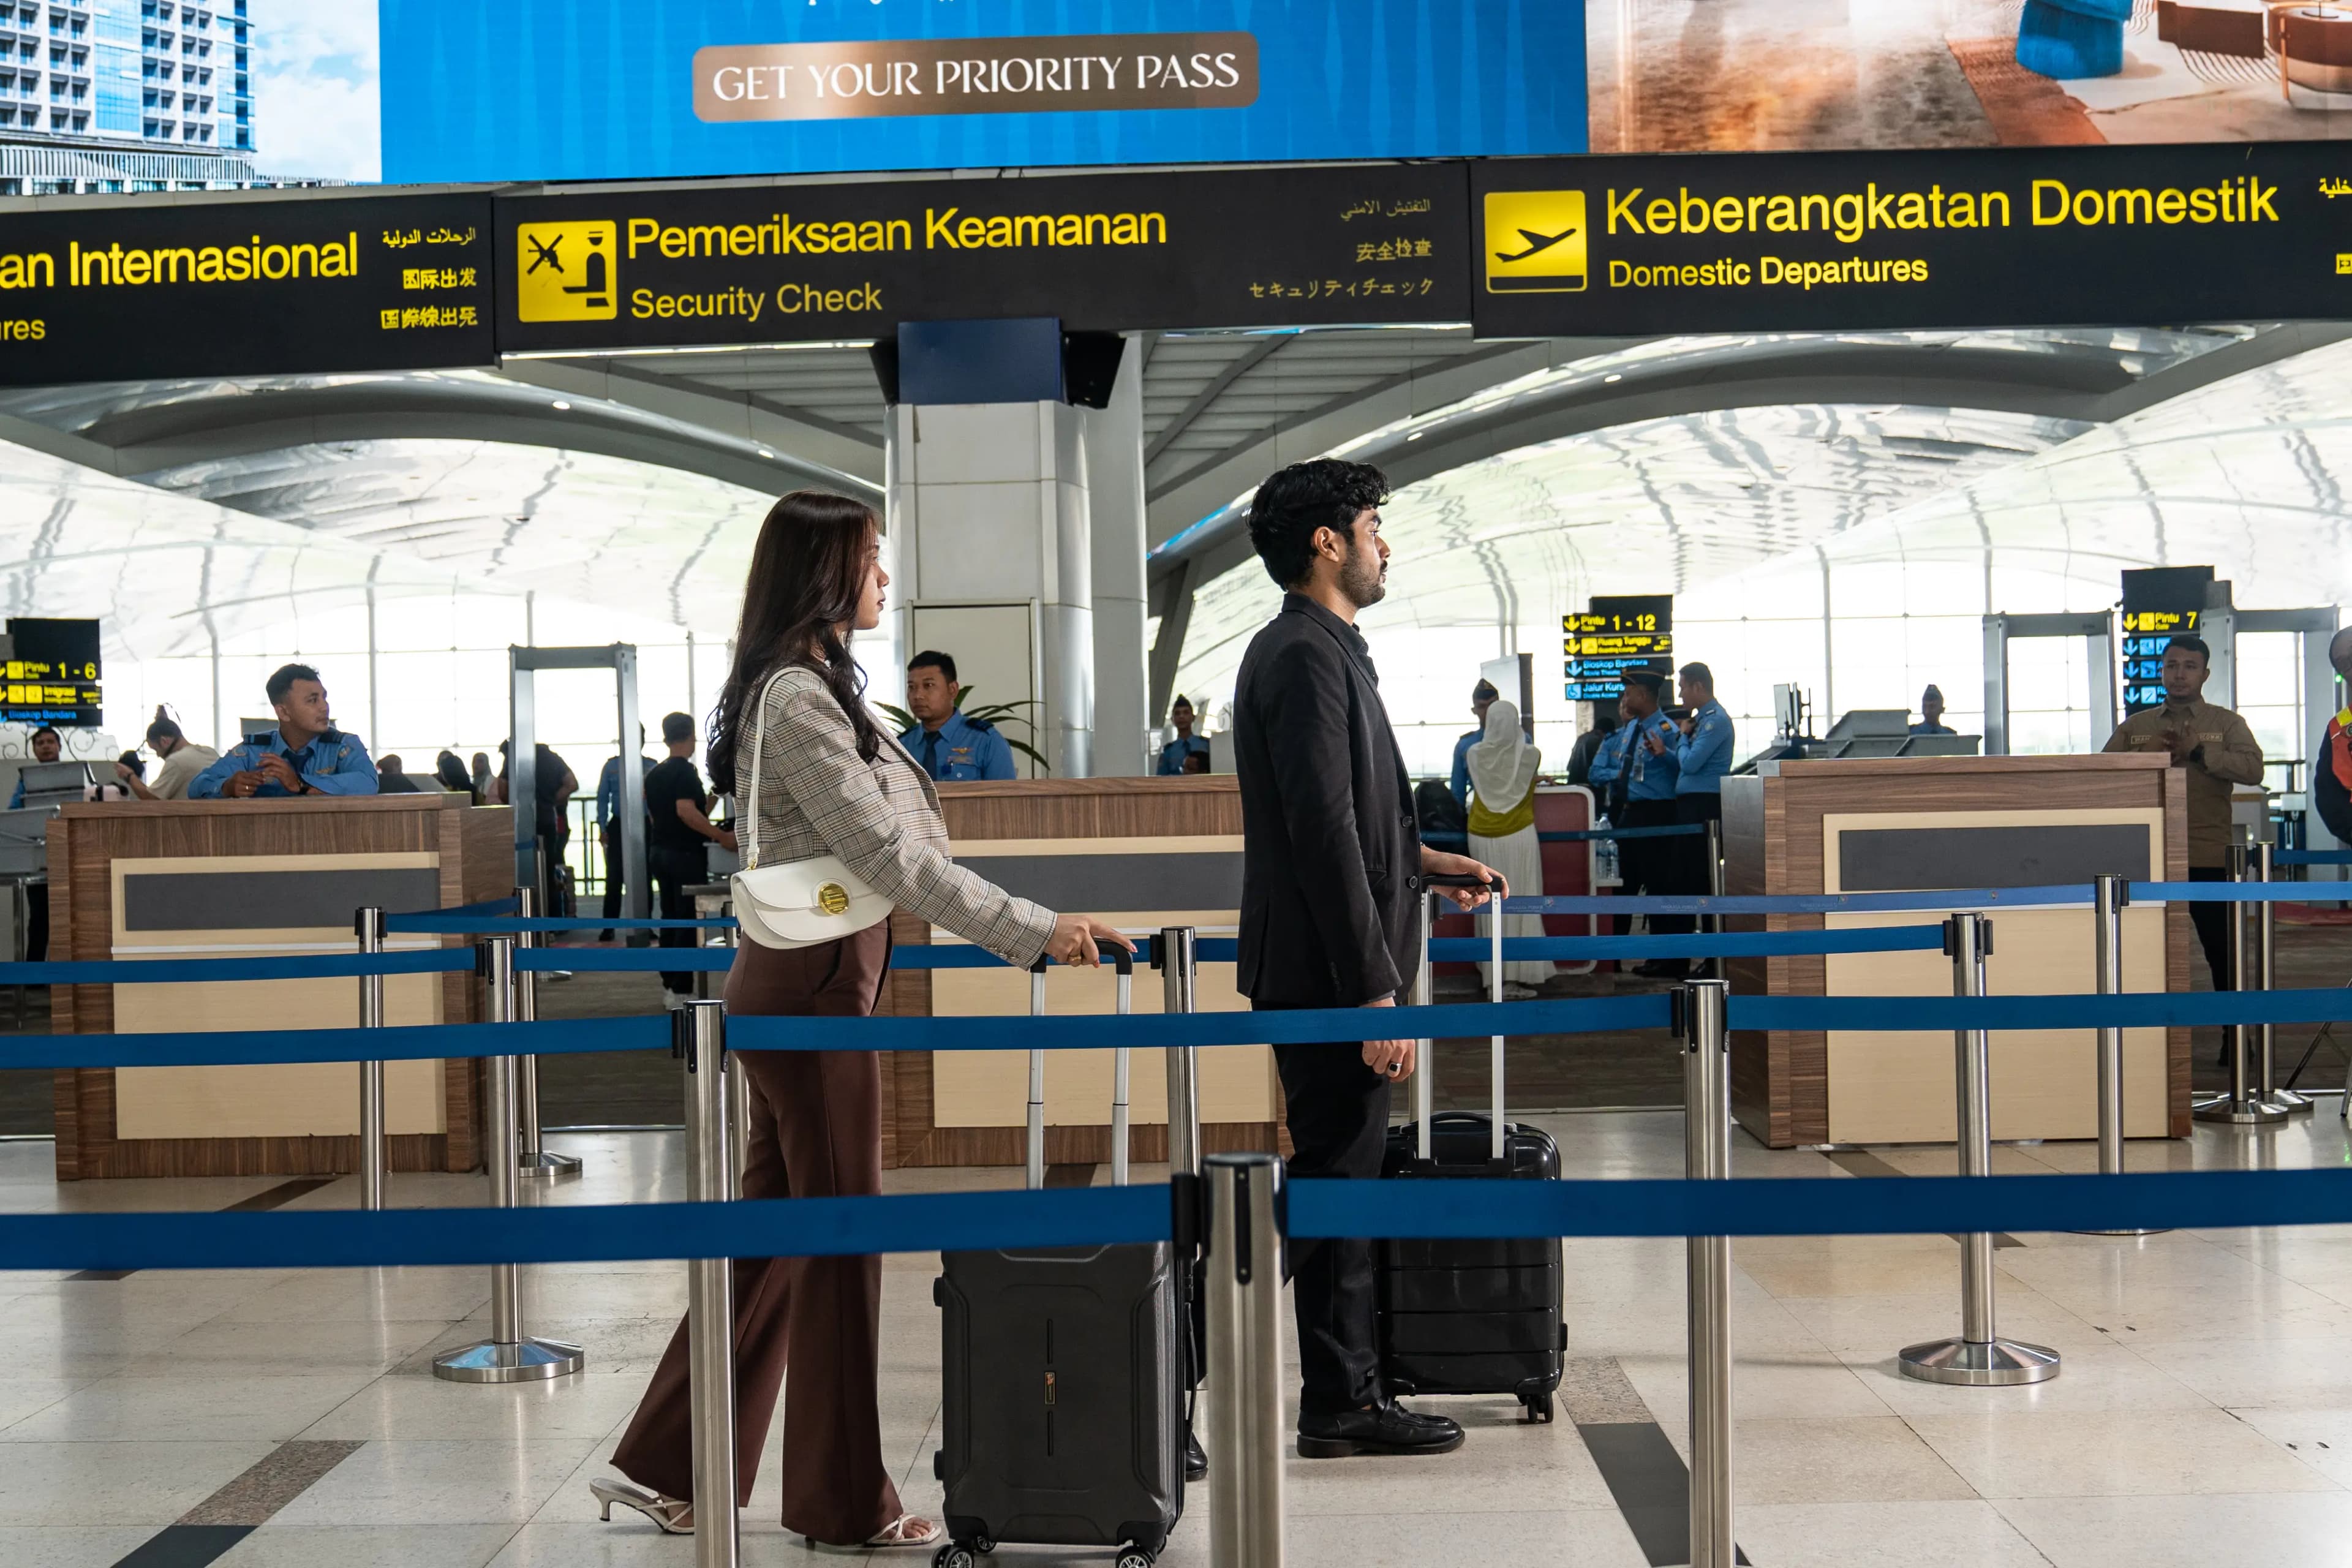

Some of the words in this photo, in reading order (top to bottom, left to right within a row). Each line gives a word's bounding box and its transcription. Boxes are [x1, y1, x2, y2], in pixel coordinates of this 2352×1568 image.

[714, 65, 794, 100] GET
[807, 62, 921, 97] YOUR
[937, 57, 1122, 94] PRIORITY
[1137, 53, 1240, 89] PASS
[1607, 182, 2010, 243] Keberangkatan
[2032, 176, 2280, 226] Domestik
[426, 227, 476, 246] الرحلات
[628, 213, 912, 258] Pemeriksaan
[925, 207, 1167, 249] Keamanan
[0, 252, 55, 289] an
[70, 231, 358, 287] Internasional
[1609, 257, 1751, 287] Domestic
[1760, 255, 1929, 290] Departures
[1250, 277, 1433, 298] セキュリティチェック
[631, 286, 765, 322] Security
[776, 282, 883, 314] Check
[0, 319, 45, 340] res
[1581, 616, 1606, 625] Pintu
[1613, 614, 1621, 631] 1
[1636, 614, 1656, 631] 12
[2155, 612, 2180, 624] Pintu
[2187, 611, 2197, 629] 7
[58, 662, 66, 679] 1
[85, 662, 96, 679] 6
